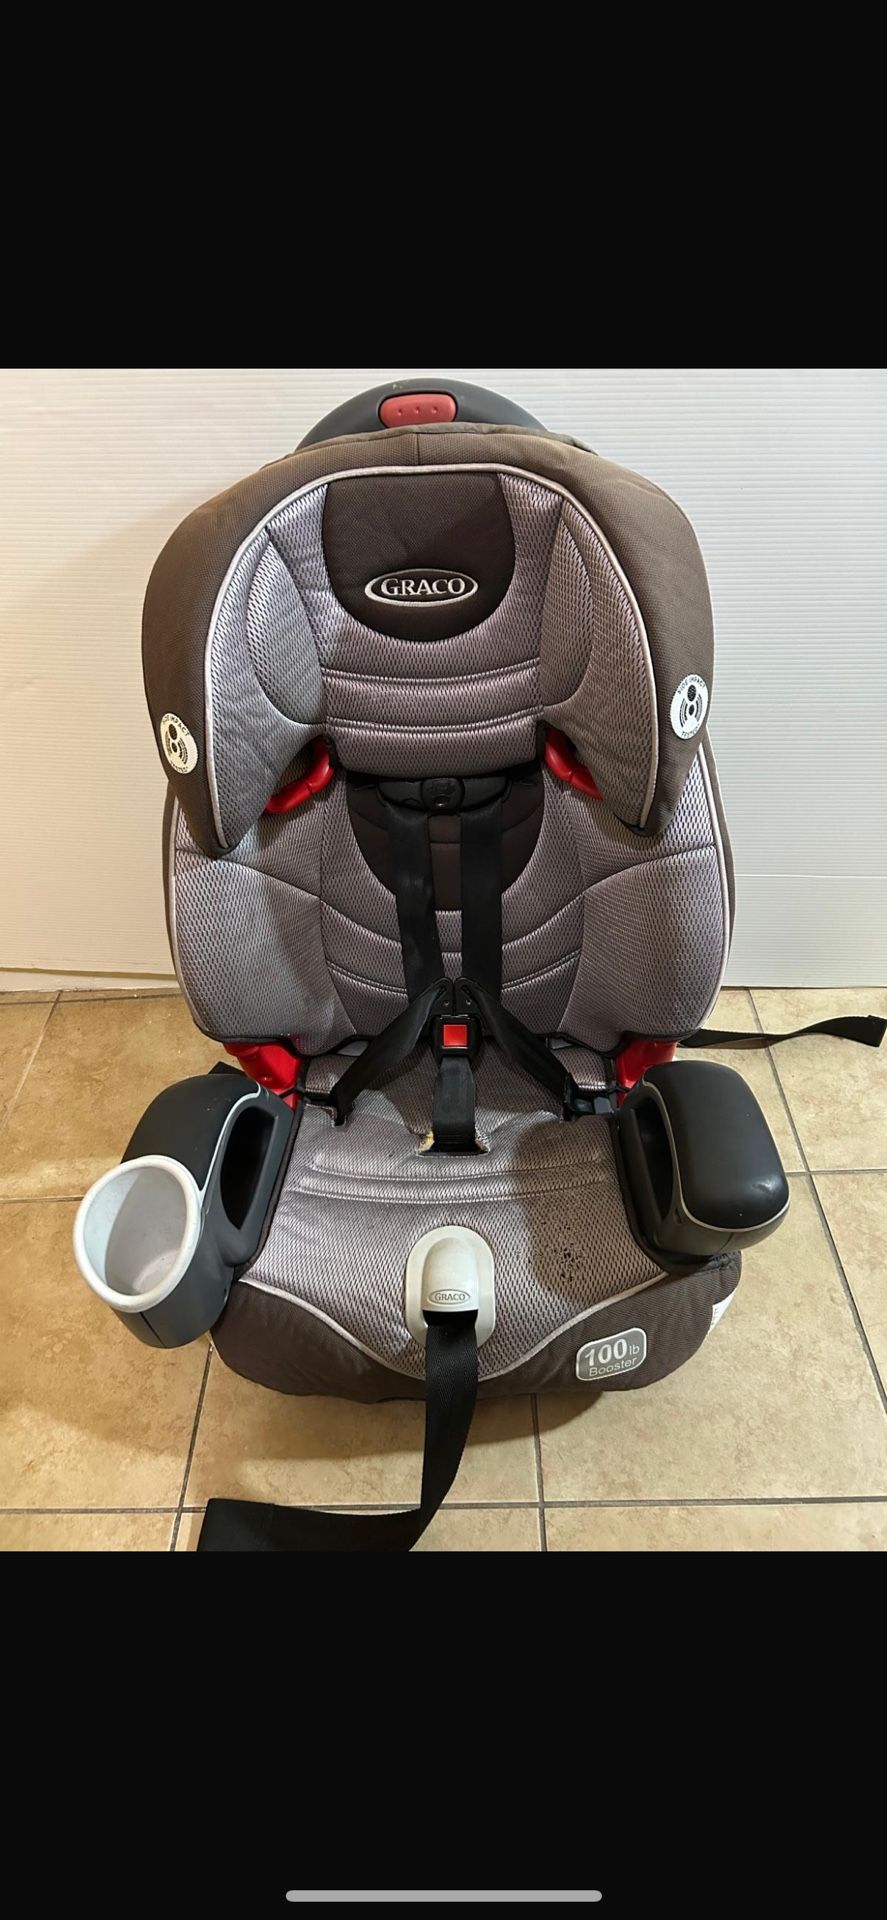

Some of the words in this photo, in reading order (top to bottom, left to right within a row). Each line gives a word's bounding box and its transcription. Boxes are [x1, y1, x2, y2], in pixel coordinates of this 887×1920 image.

[380, 577, 466, 597] GRACO
[434, 1292, 466, 1301] GRACO
[584, 1338, 628, 1367] 100
[628, 1344, 640, 1356] lb
[589, 1357, 638, 1377] Booster
